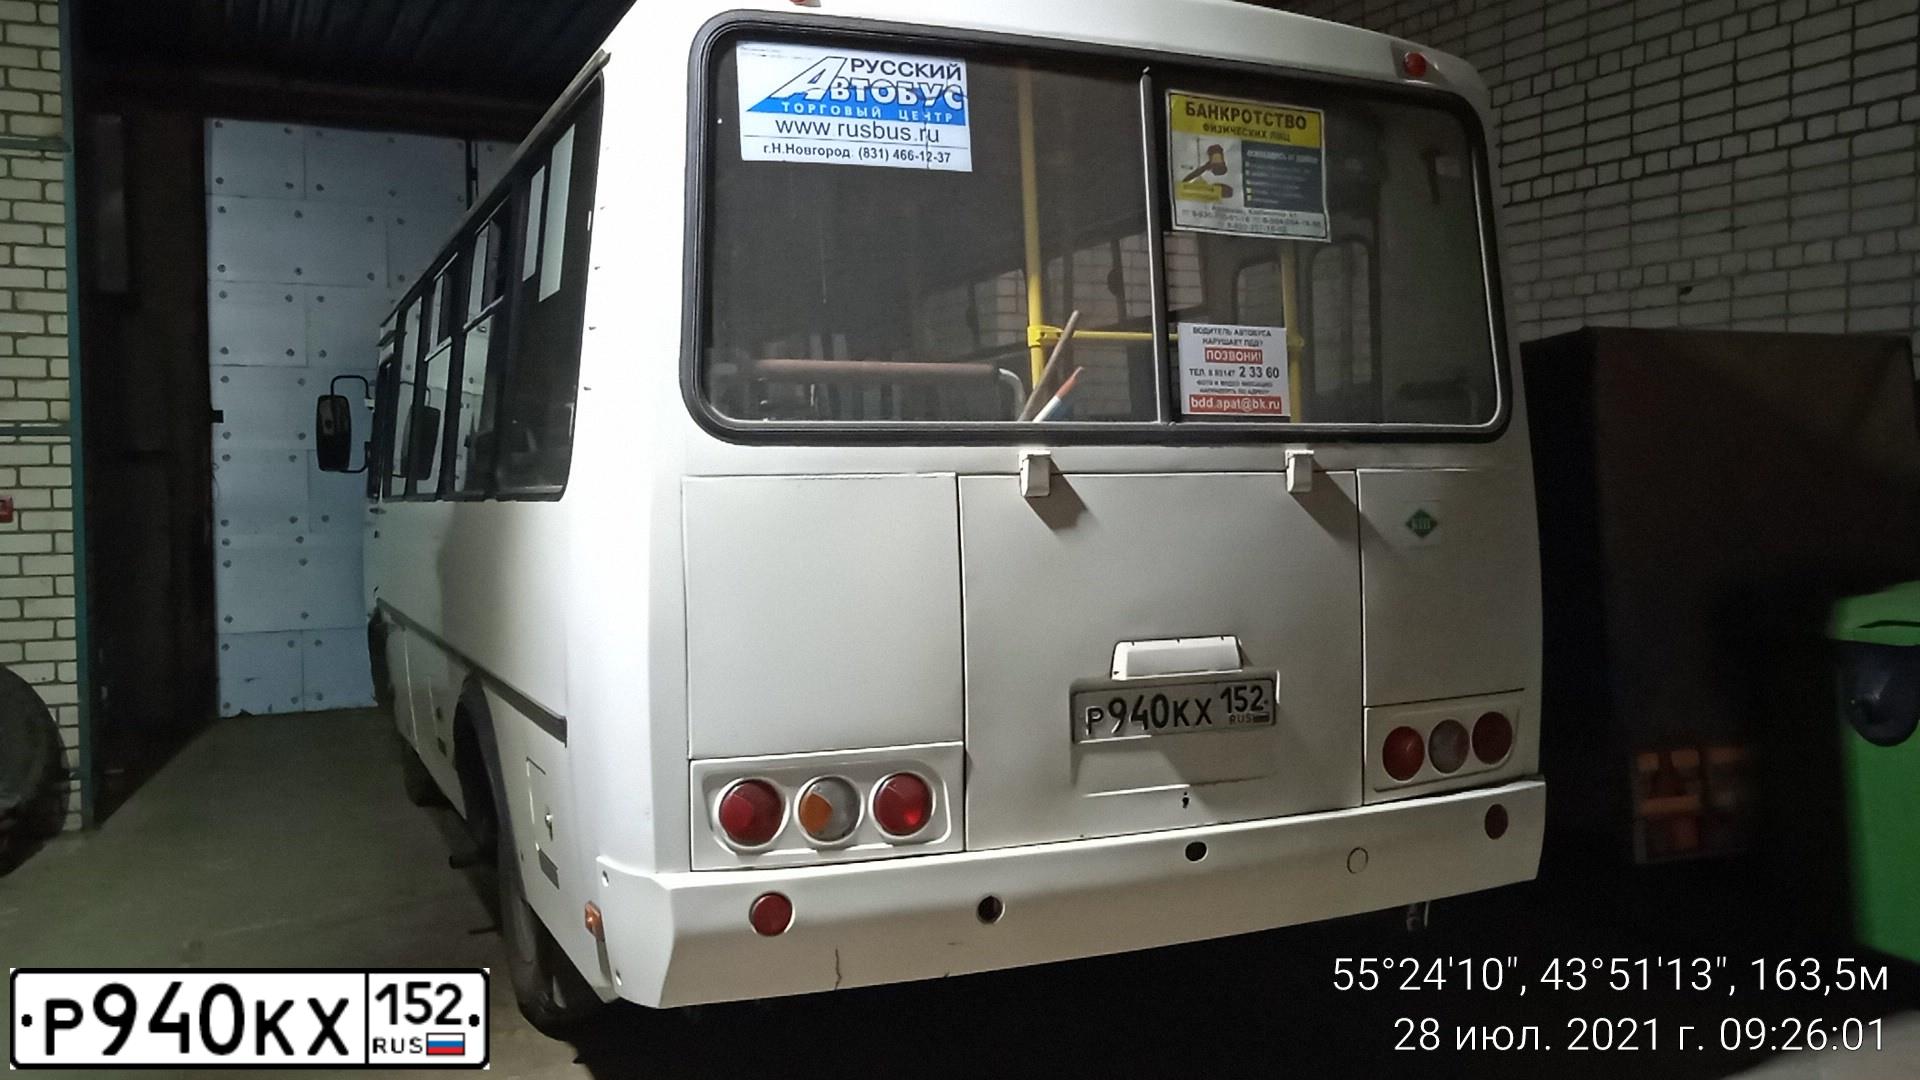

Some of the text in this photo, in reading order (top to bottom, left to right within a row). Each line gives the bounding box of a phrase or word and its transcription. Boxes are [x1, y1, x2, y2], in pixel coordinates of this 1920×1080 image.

[850, 58, 962, 81] РУССКИЙ
[768, 56, 965, 110] АВТОБУС
[781, 101, 953, 122] ТОРГОВЫЙ ЦЕНТР
[1185, 101, 1307, 130] БАНКРОТСТВО
[1202, 123, 1267, 139] ФИЗИЧЕСКИХ
[858, 148, 889, 161] (831)
[893, 149, 951, 163] 466-12-37
[1193, 327, 1271, 337] ВОДИТЕЛЬ АВТОБУСА
[1202, 338, 1242, 346] НАРУШАЕТ
[1206, 350, 1261, 362] ПОЗВОНИ!
[1239, 366, 1246, 378] 2
[1249, 366, 1263, 378] 33
[1265, 366, 1280, 378] 60
[1190, 396, 1280, 412] bdd.apat@bk.ru
[1086, 685, 1265, 736] Р940КХ 152
[1229, 713, 1252, 725] RUS
